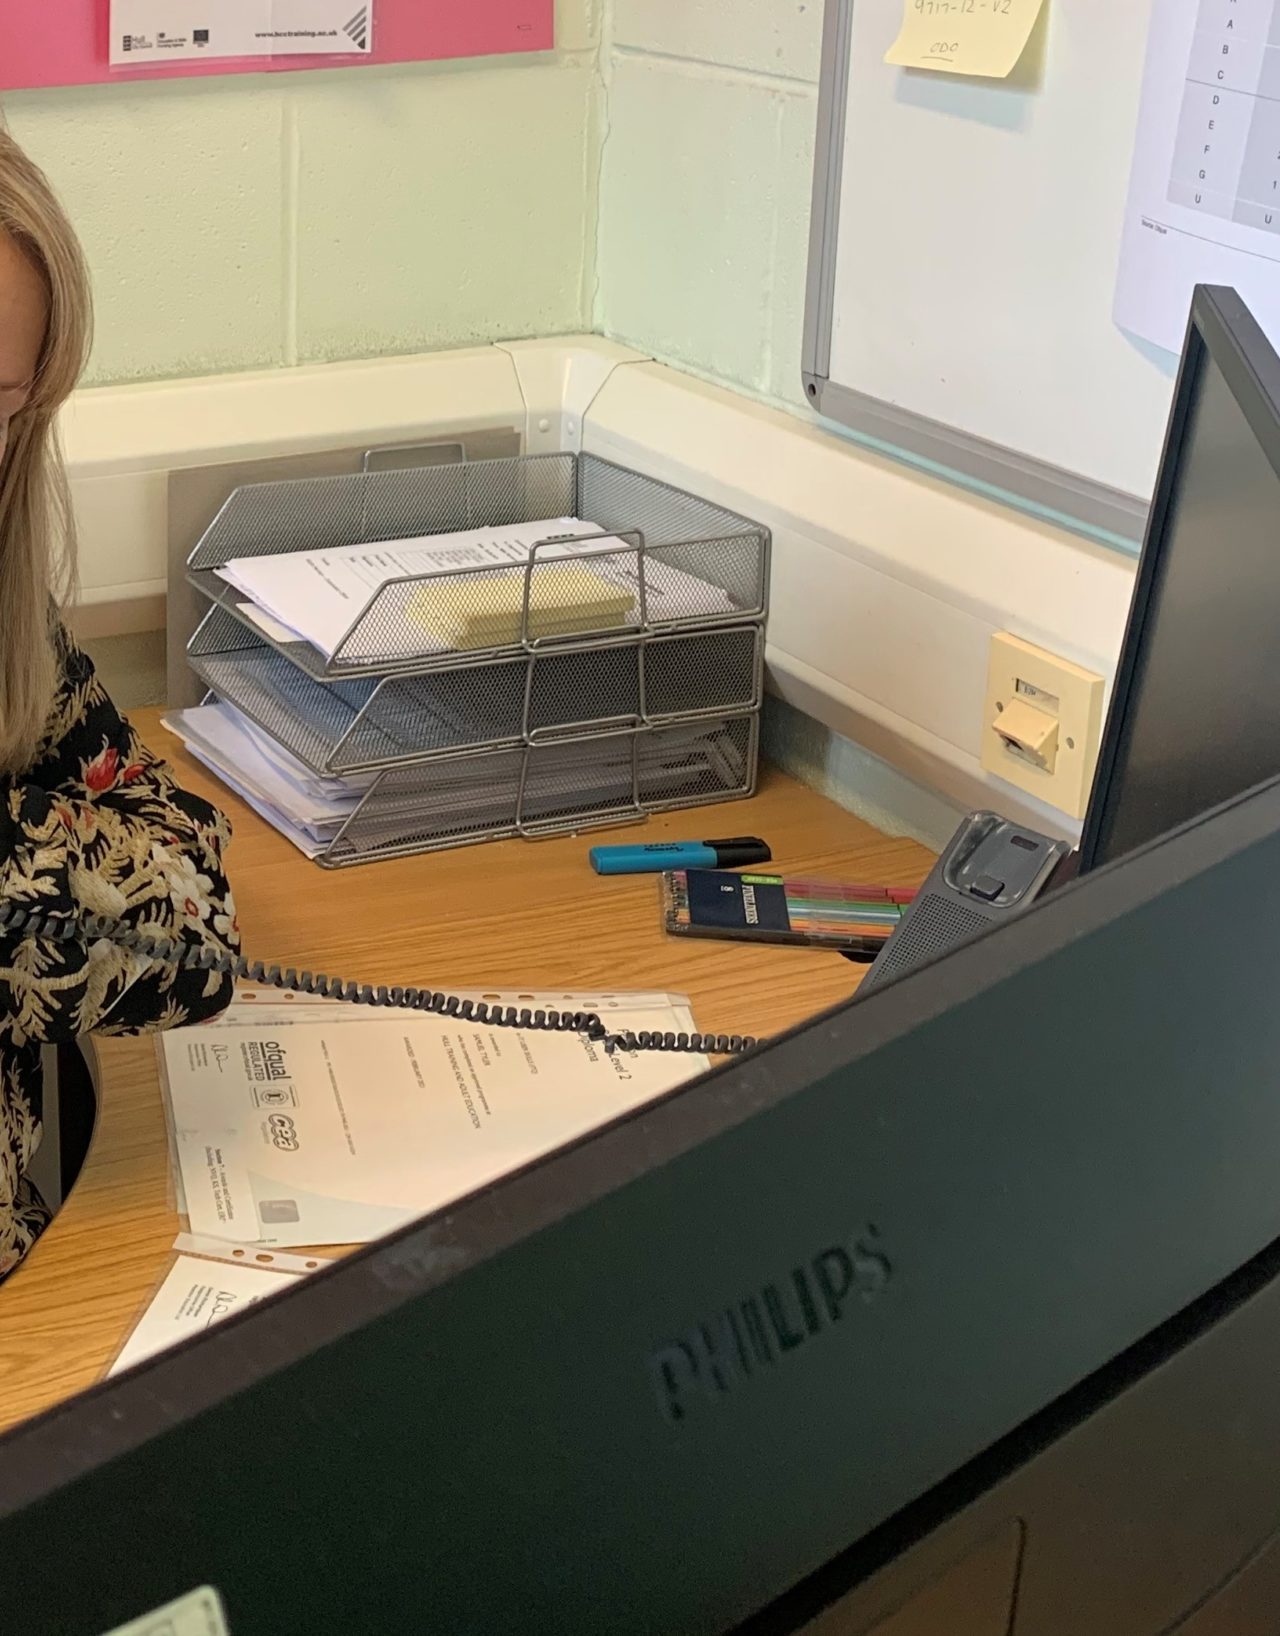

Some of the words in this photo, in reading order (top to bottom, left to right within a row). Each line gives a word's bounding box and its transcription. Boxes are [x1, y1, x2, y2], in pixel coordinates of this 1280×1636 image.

[1226, 19, 1234, 29] A
[1222, 44, 1229, 54] B
[1217, 70, 1224, 80] C
[1212, 96, 1220, 105] D
[1208, 120, 1214, 130] E
[1204, 144, 1210, 154] F
[1199, 170, 1206, 180] G
[1194, 194, 1202, 204] U
[1264, 215, 1272, 224] U
[441, 1034, 451, 1048] HULL
[248, 1042, 265, 1081] REGULATED
[264, 1041, 292, 1080] ofqual
[447, 1048, 460, 1071] TRAINING
[608, 1053, 629, 1072] Level
[456, 1070, 464, 1082] AND
[459, 1082, 471, 1098] ADULT
[464, 1098, 482, 1129] EDUCATION
[654, 1222, 893, 1422] PHILIPS
